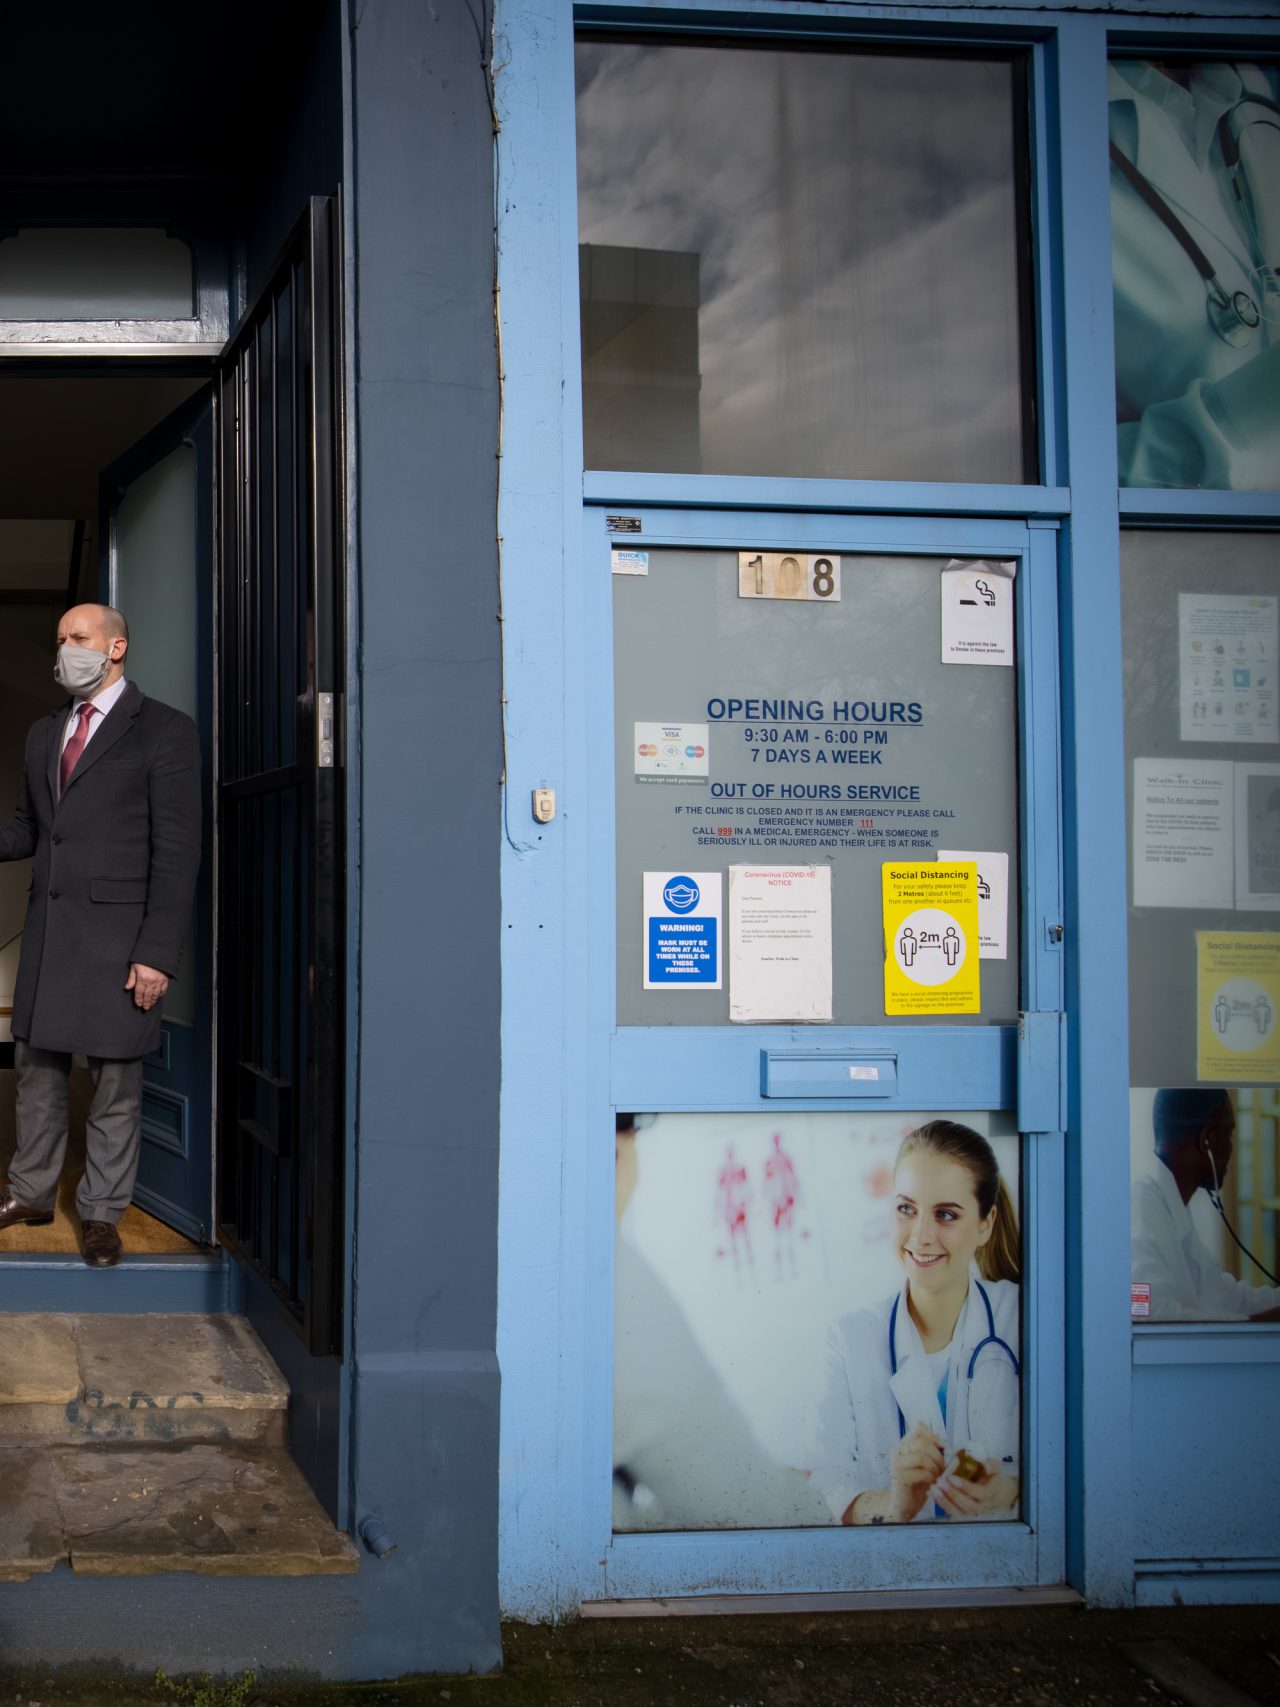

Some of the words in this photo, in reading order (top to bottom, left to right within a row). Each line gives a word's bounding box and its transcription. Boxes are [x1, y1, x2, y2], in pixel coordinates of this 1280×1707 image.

[748, 555, 834, 597] 108
[707, 698, 824, 721] OPENING
[833, 701, 923, 722] HOURS
[744, 728, 778, 742] 9:30
[783, 729, 808, 743] AM
[825, 730, 858, 744] 6:00
[864, 731, 888, 744] PM
[751, 749, 760, 762] 7
[766, 749, 810, 763] DAYS
[816, 750, 827, 763] A
[832, 750, 882, 764] WEEK
[711, 783, 747, 798] OUT
[752, 784, 775, 798] OF
[781, 784, 841, 799] HOURS
[847, 785, 920, 800] SERVICE
[698, 837, 746, 845] SERIOUSLY
[920, 871, 969, 880] Distancing
[920, 932, 940, 942] 2m
[1232, 1000, 1251, 1010] 2m
